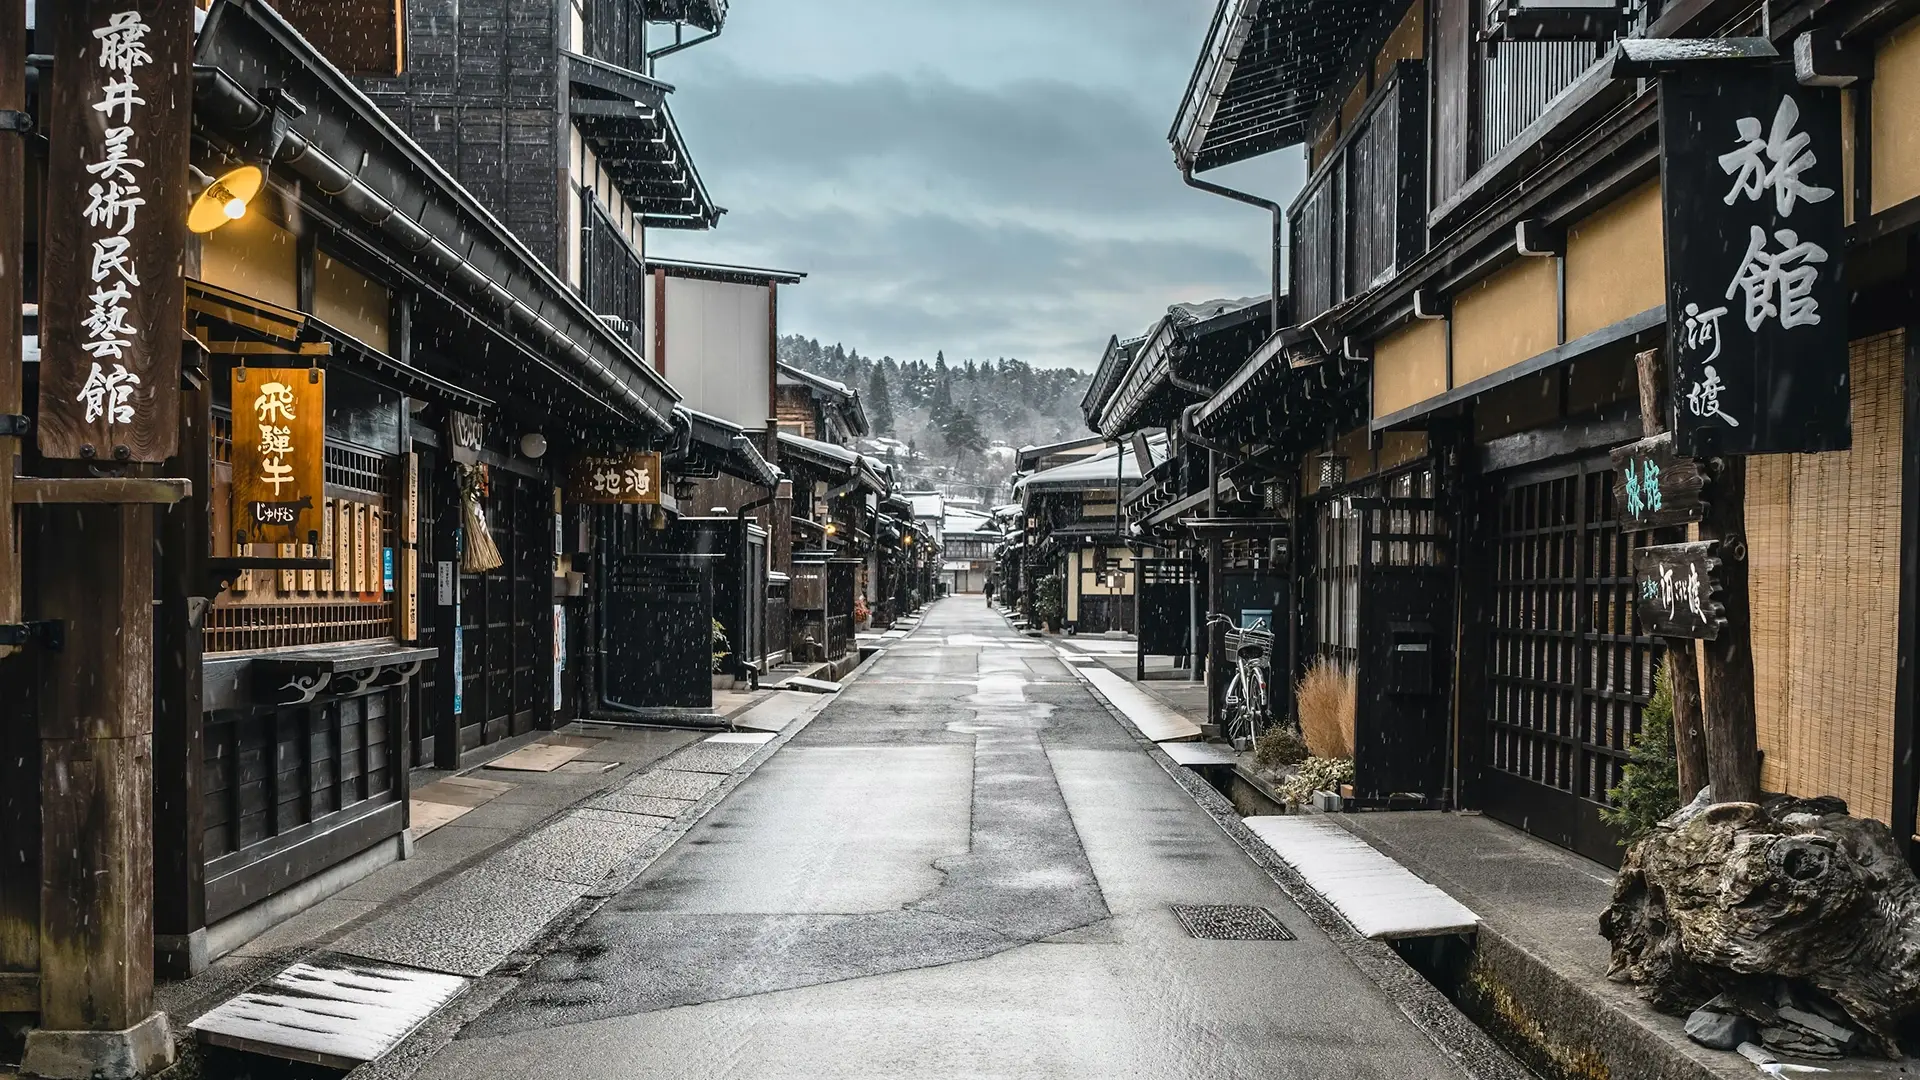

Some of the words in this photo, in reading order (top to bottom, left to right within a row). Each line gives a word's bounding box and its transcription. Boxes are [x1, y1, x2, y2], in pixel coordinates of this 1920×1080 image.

[77, 11, 152, 424] 藤井美術民藝館
[1718, 94, 1834, 332] 旅館
[257, 503, 294, 522] じゅげむ
[593, 467, 650, 495] 地酒
